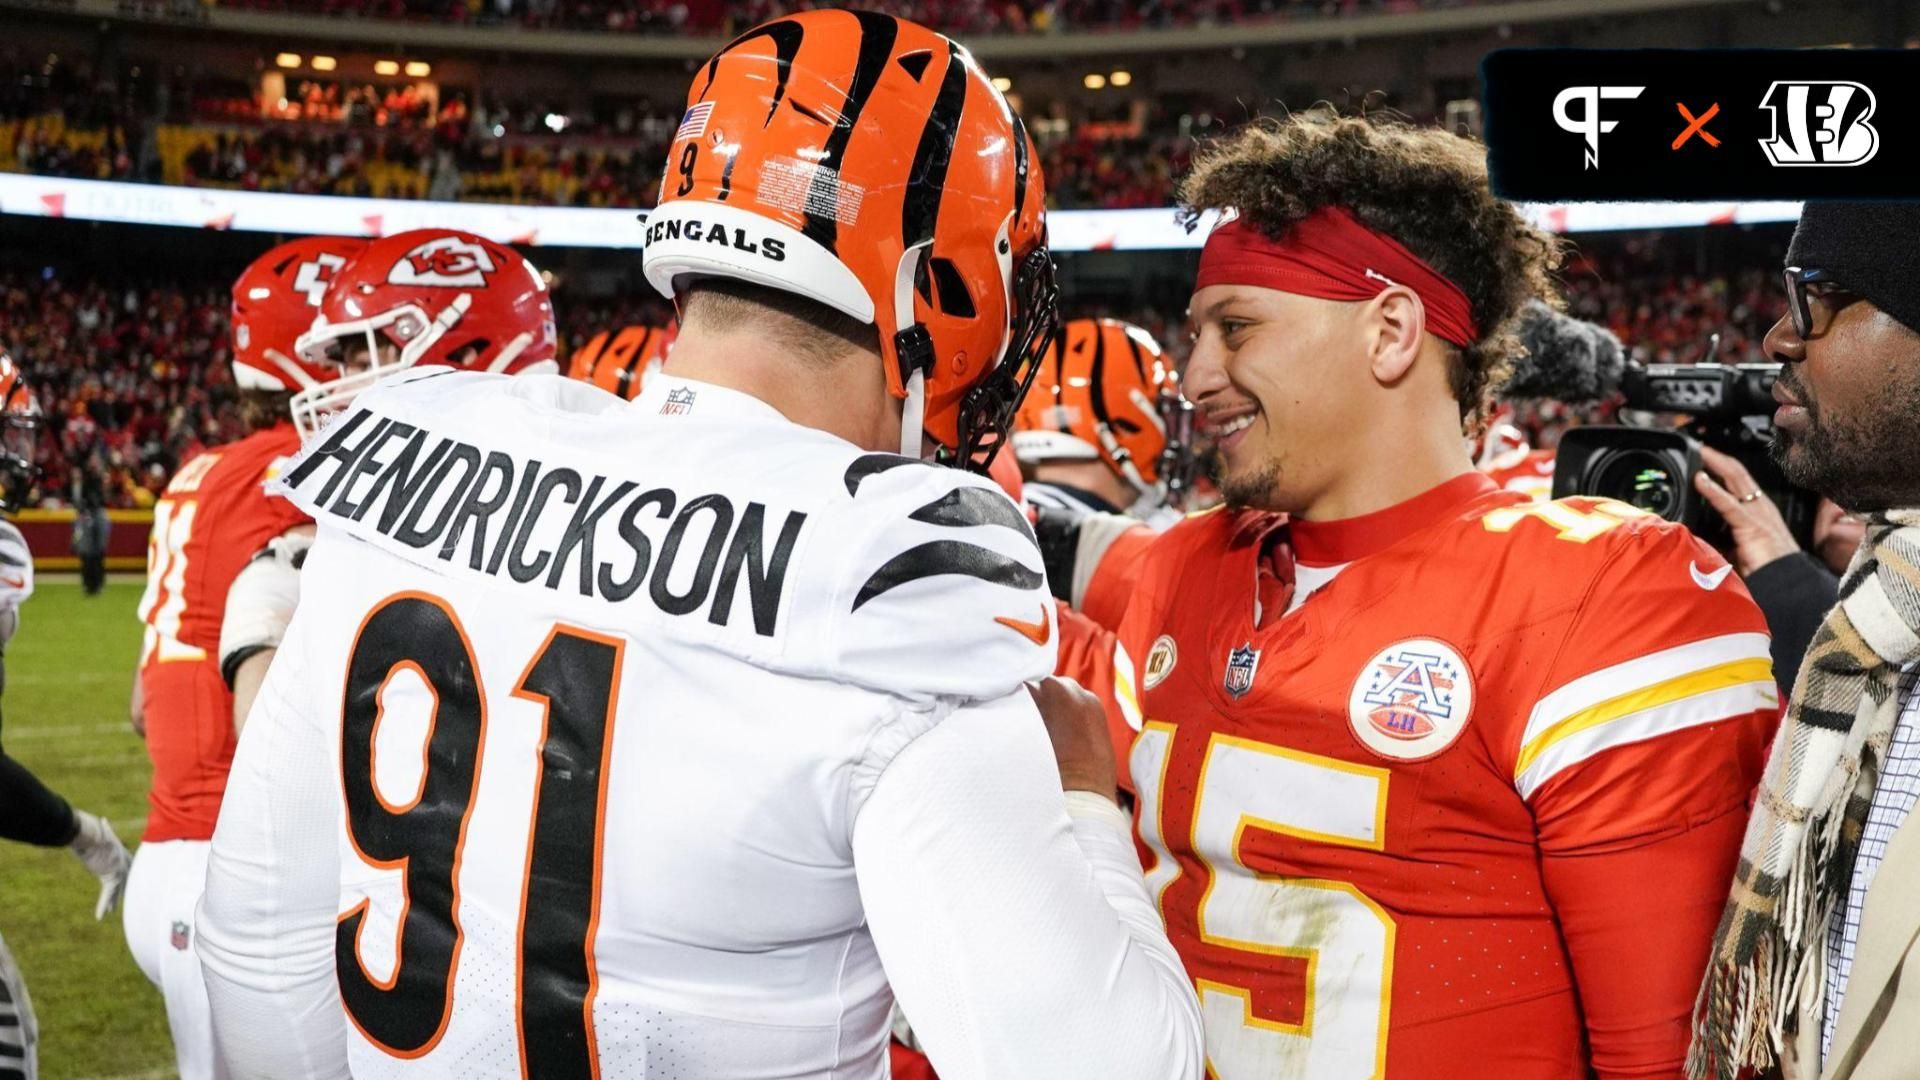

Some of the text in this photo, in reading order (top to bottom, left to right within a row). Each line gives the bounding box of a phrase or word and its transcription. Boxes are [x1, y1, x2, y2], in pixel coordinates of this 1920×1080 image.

[645, 219, 786, 262] BENGALS
[283, 407, 808, 638] HENDRICKSON
[1227, 666, 1249, 689] NFL
[1363, 651, 1452, 719] A
[1387, 711, 1417, 733] LH
[334, 588, 628, 1080] 91
